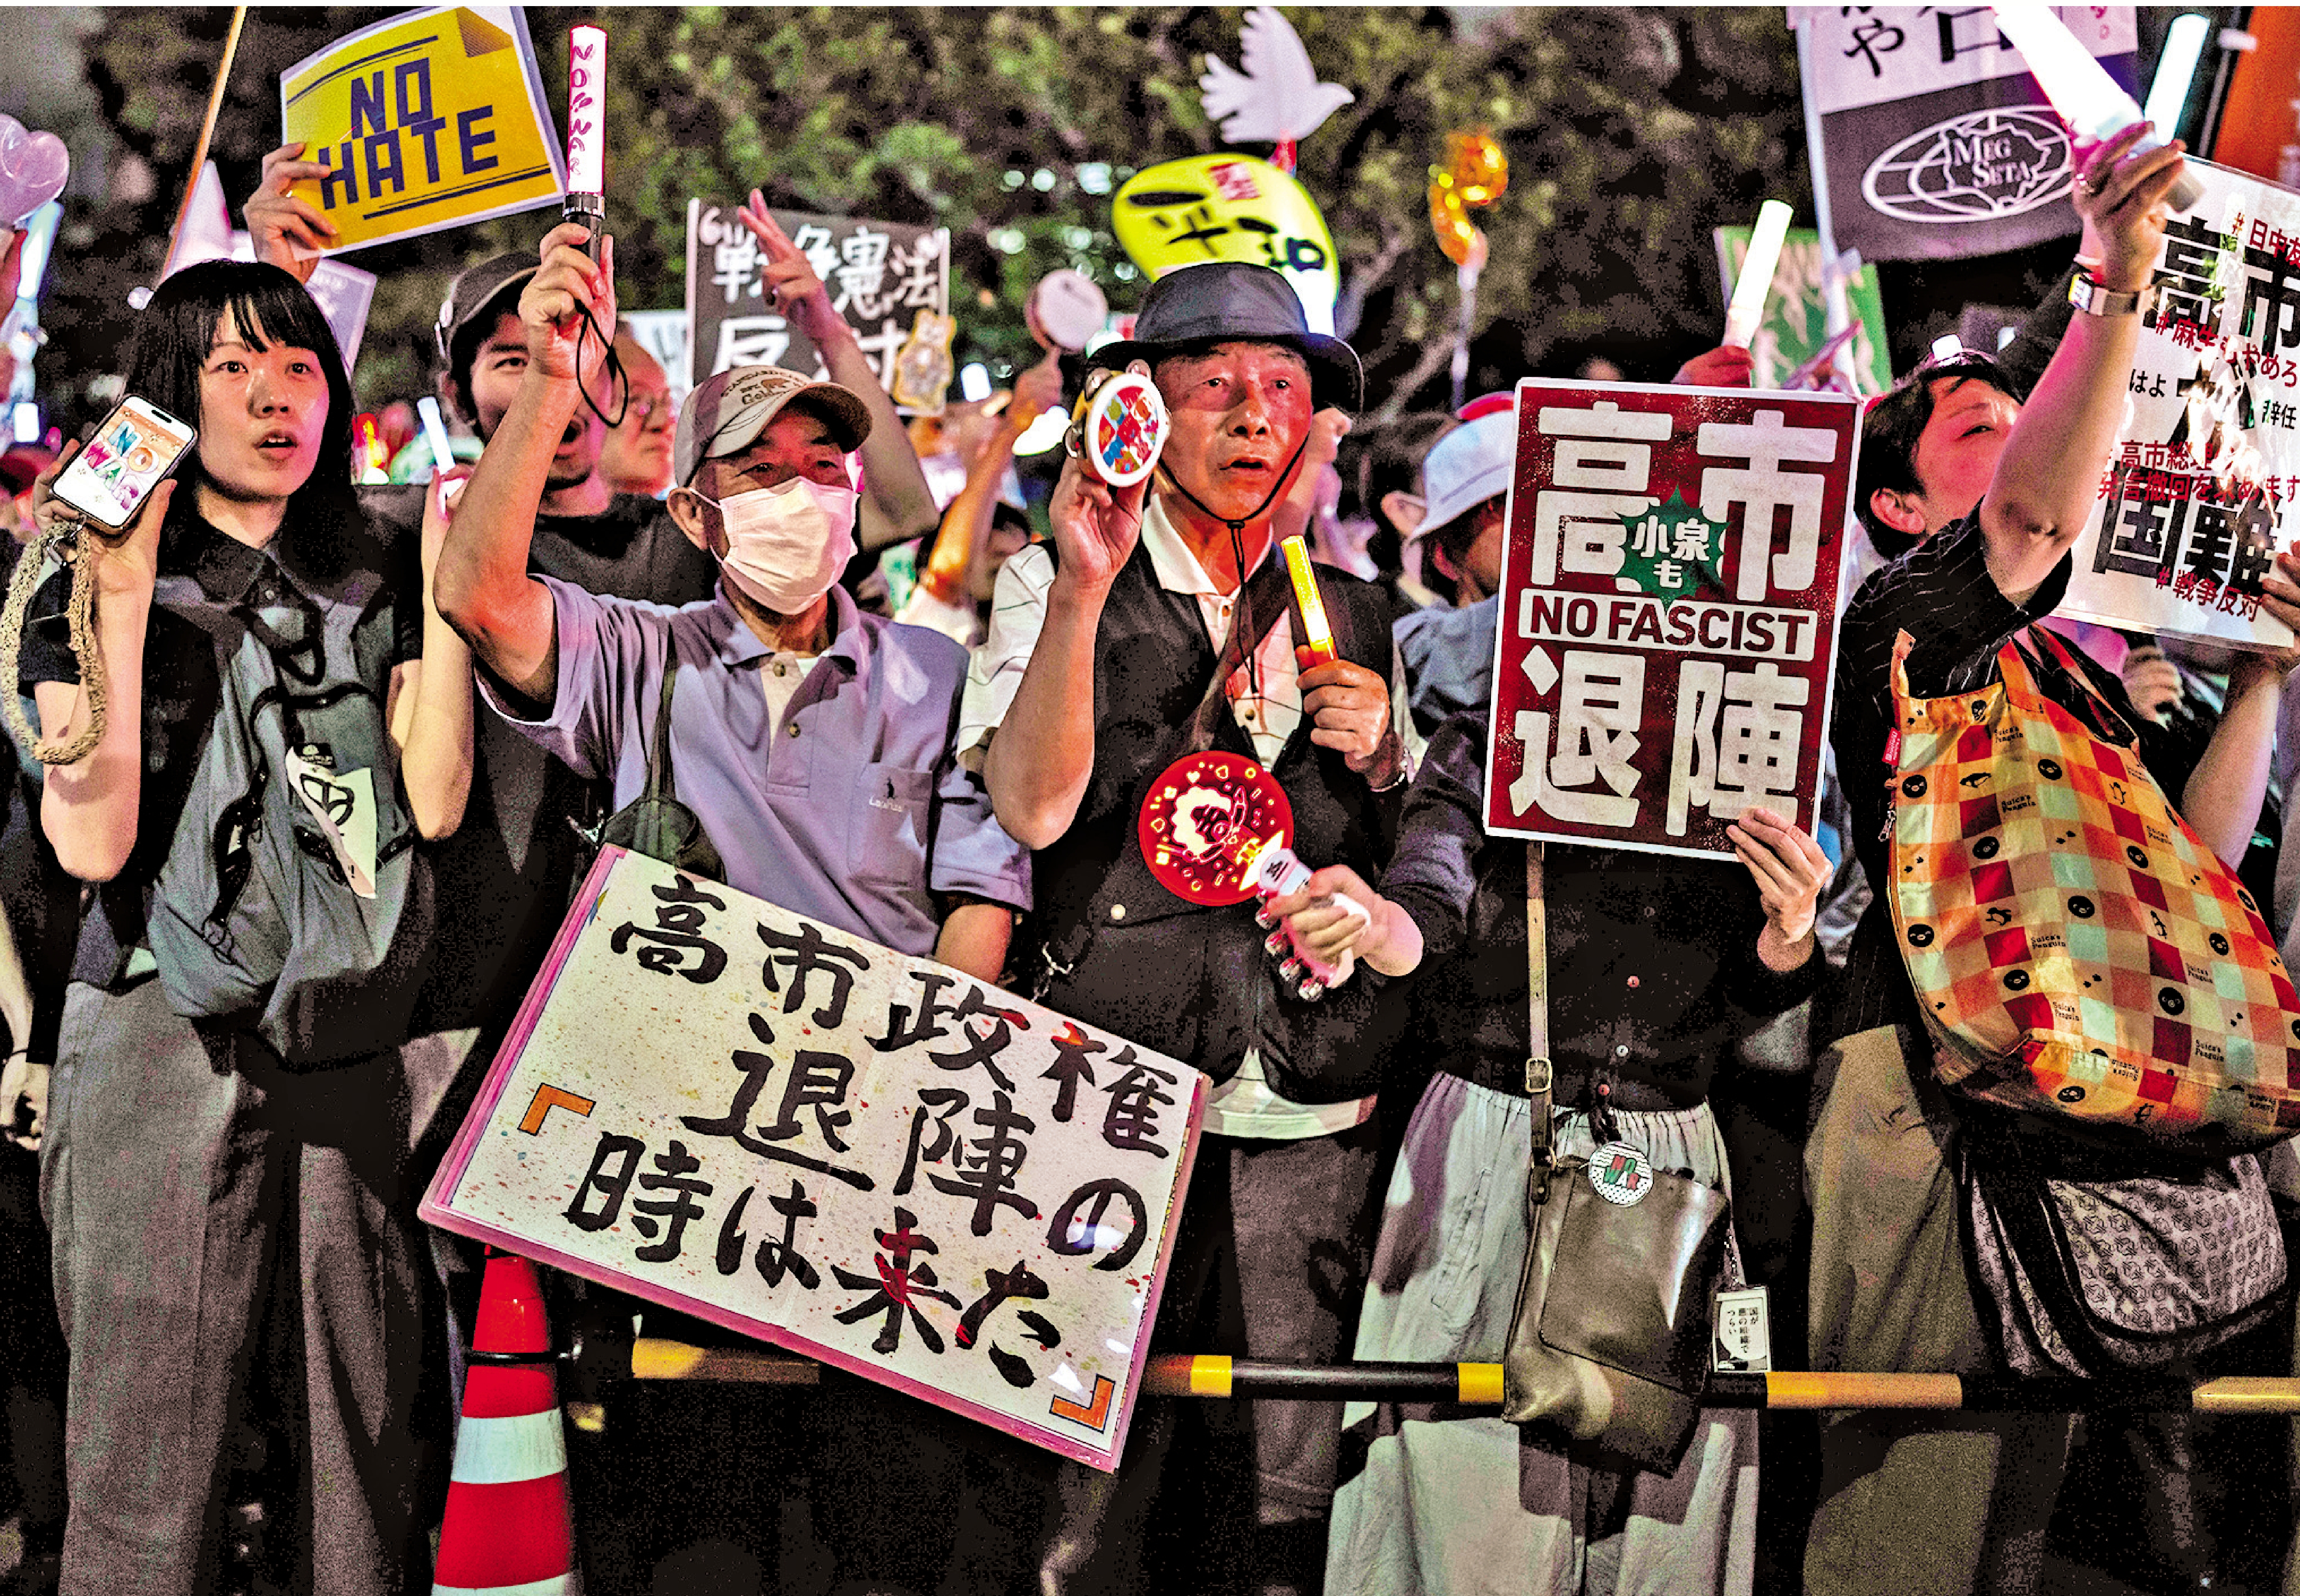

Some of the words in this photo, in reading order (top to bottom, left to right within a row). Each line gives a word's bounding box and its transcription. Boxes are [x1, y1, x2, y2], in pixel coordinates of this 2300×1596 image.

[351, 57, 433, 140] NO
[318, 105, 499, 210] HATE
[2142, 215, 2300, 358] 高市
[2129, 368, 2166, 398] はよ
[84, 439, 141, 511] WAR
[107, 420, 154, 472] NO
[1531, 401, 1838, 602] 高市
[1631, 514, 1711, 562] 小泉
[2092, 460, 2283, 596] 国難
[1654, 559, 1683, 589] も
[1530, 595, 1598, 638] NO
[1607, 602, 1810, 656] FASCIST
[1508, 644, 1810, 837] 退陣
[611, 874, 1178, 1159] 高市政権
[678, 1012, 1148, 1271] 退陣の
[1603, 1166, 1640, 1192] WAR
[1610, 1154, 1638, 1174] NO
